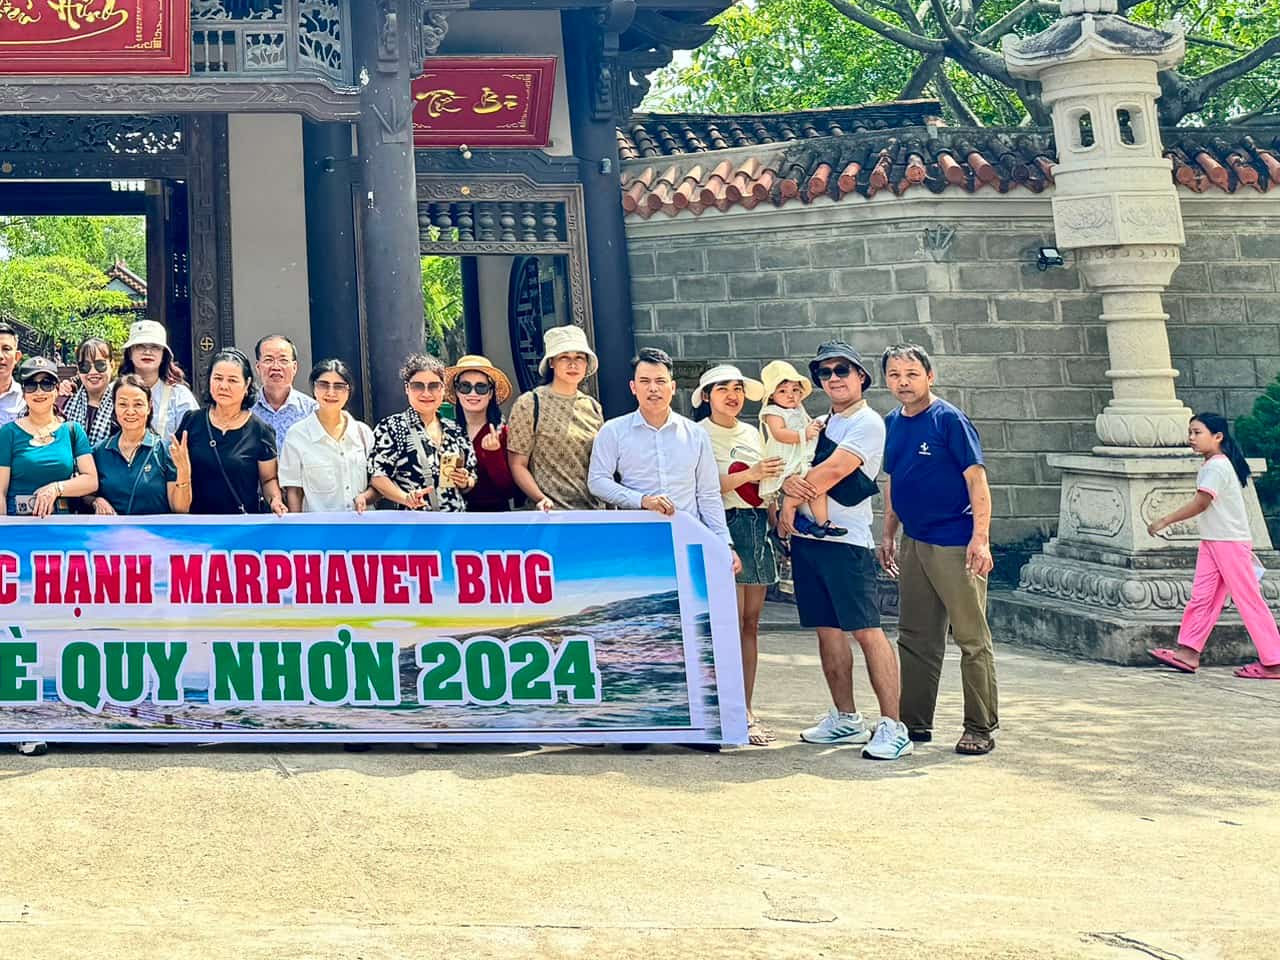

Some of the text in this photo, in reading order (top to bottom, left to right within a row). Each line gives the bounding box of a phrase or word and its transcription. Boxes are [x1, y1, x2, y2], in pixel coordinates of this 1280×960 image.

[33, 553, 154, 618] HẠNH
[169, 553, 440, 605] MARPHAVET
[455, 552, 554, 605] BMG
[62, 641, 187, 709] QUY
[213, 628, 396, 703] NHƠN
[420, 640, 597, 702] 2024
